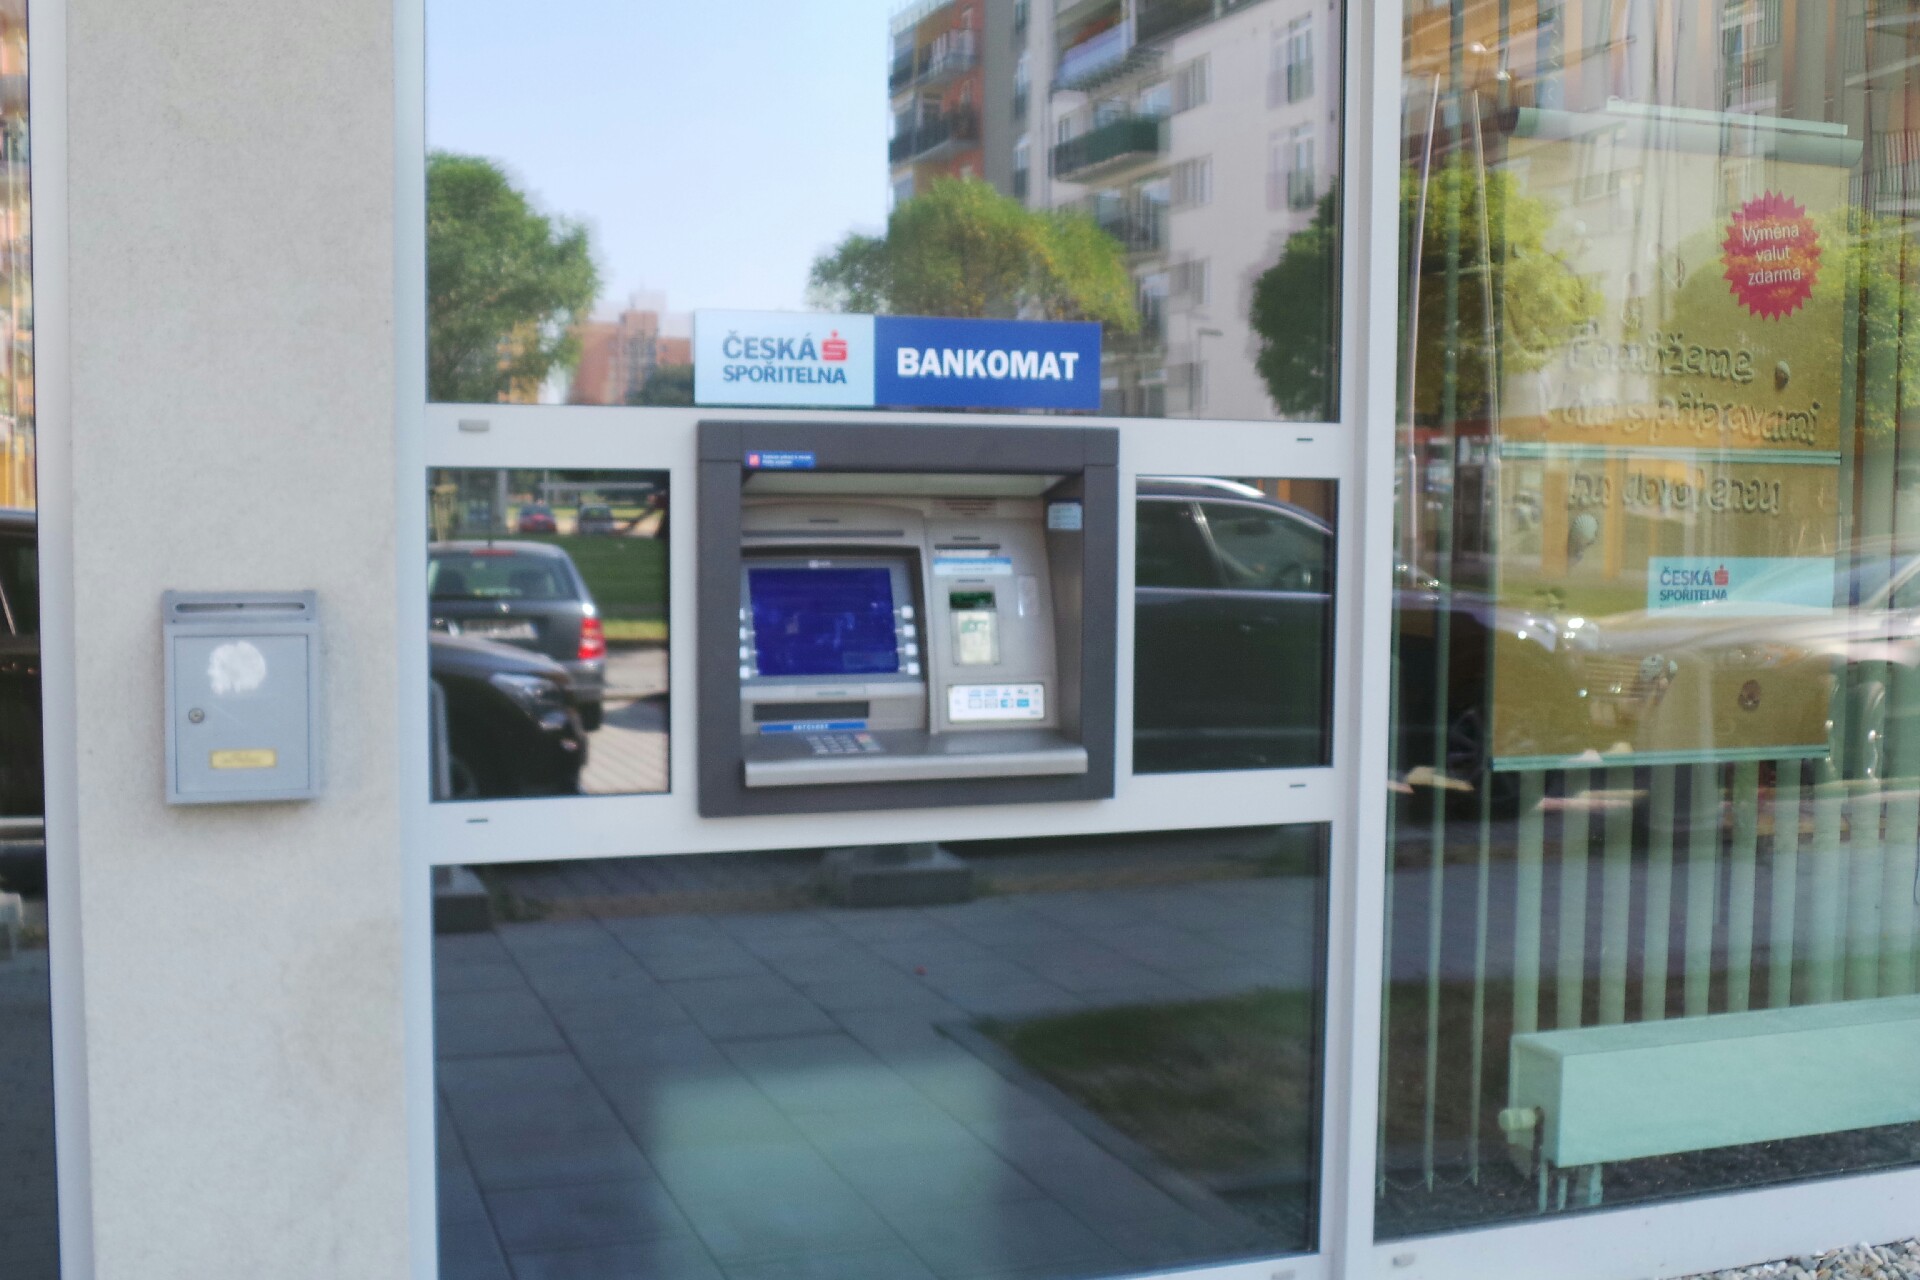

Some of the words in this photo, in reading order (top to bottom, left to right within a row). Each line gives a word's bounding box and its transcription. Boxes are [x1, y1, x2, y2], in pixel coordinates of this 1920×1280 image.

[1742, 223, 1800, 246] Výměna
[1755, 245, 1791, 262] valut
[1748, 267, 1801, 286] zdarma
[722, 329, 818, 361] ČESKÁ
[722, 361, 848, 384] SPOŘITELNA
[897, 347, 1079, 381] BANKOMAT
[1659, 566, 1713, 586] ČESKÁ
[1659, 587, 1728, 602] SPOŘITELNA
